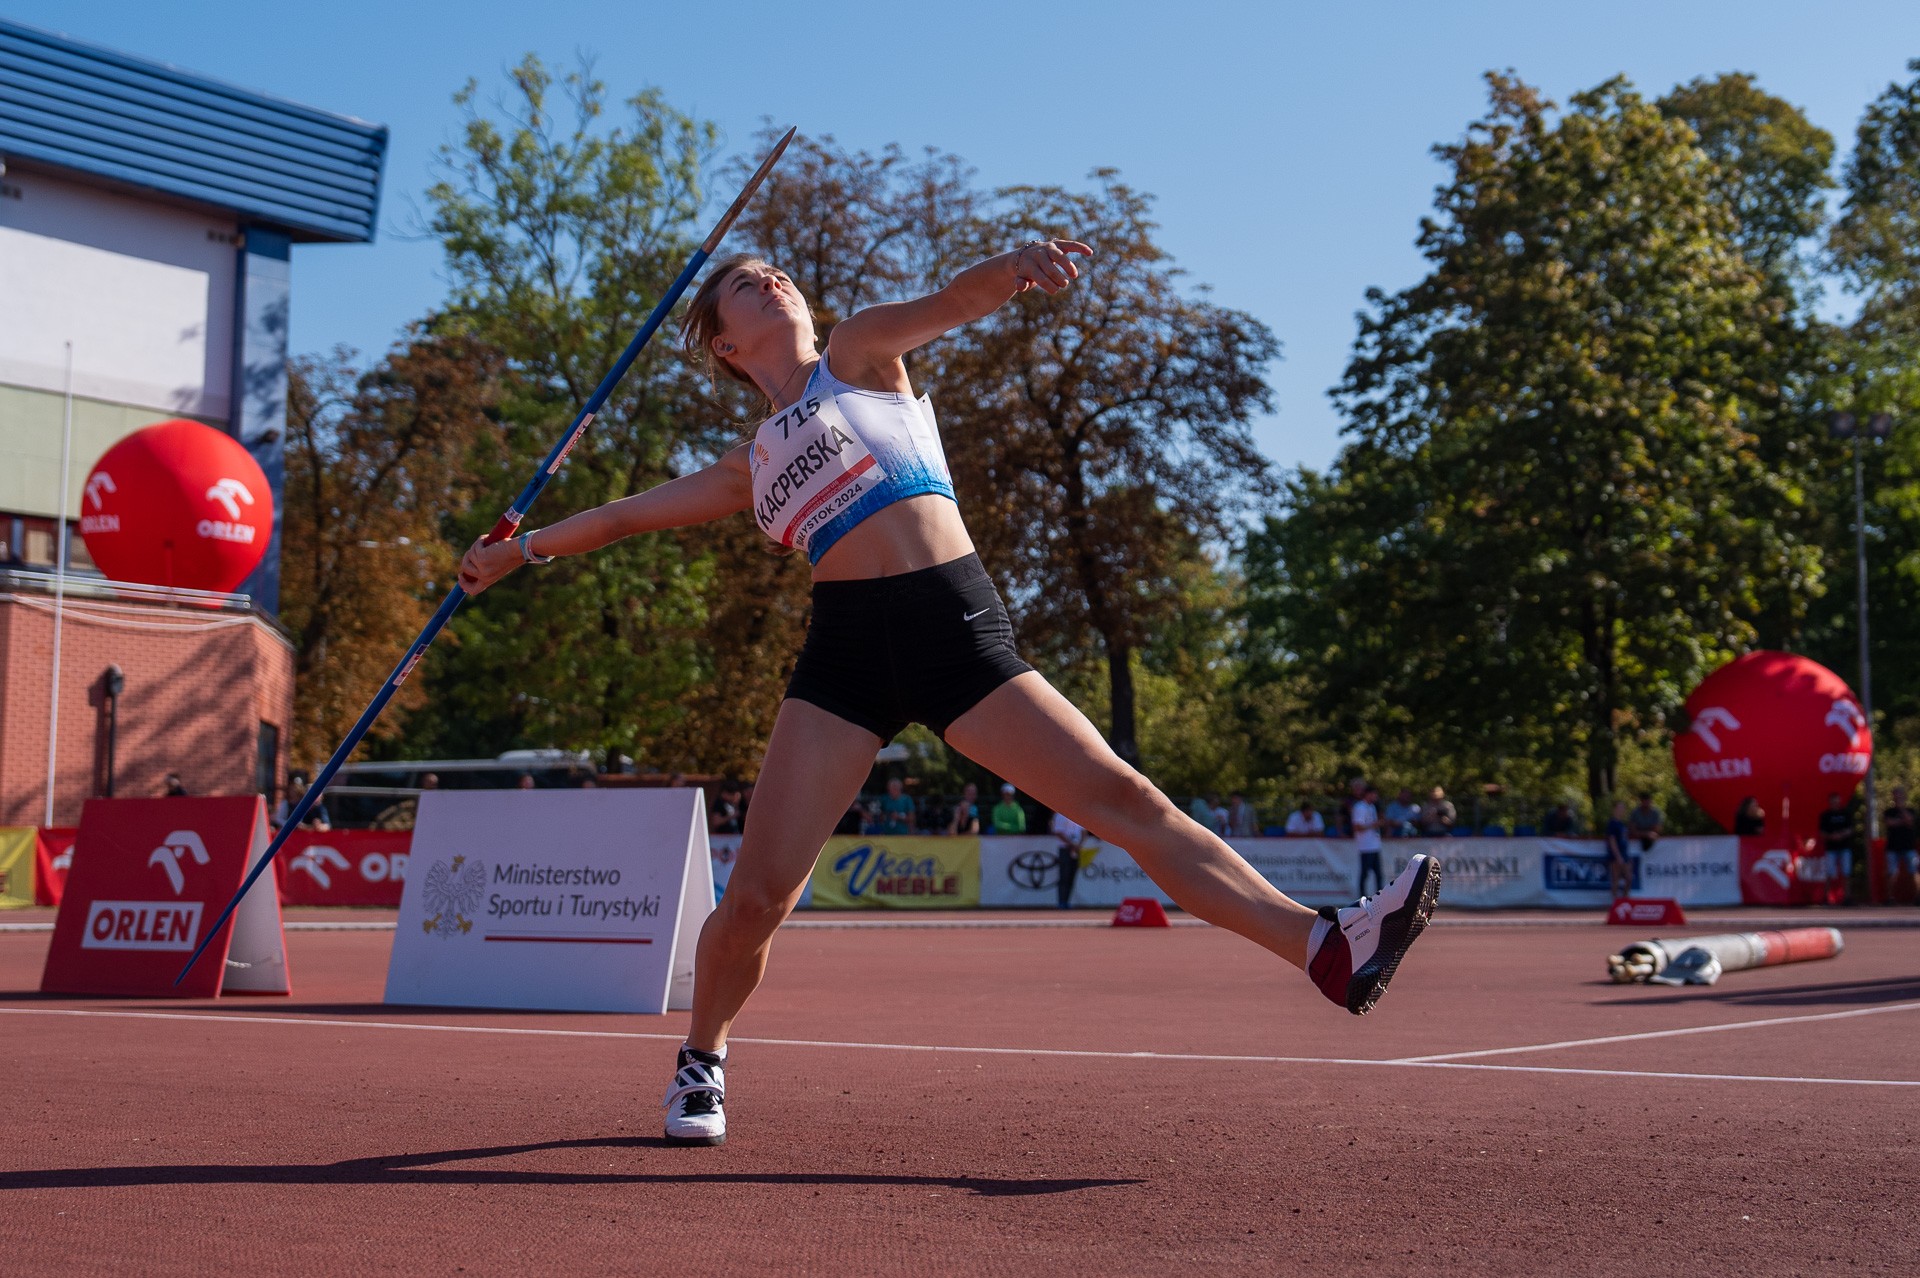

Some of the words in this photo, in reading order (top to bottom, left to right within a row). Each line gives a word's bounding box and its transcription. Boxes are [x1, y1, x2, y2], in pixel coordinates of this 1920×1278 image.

[774, 396, 821, 440] 715
[756, 425, 854, 531] KACPERSKA
[834, 483, 863, 508] 2024
[197, 520, 255, 544] ORLEN
[1687, 757, 1752, 781] ORLEN
[493, 862, 621, 886] Ministerstwo
[876, 876, 960, 896] MEBLE
[487, 893, 551, 919] Sportu
[557, 894, 564, 915] i
[570, 895, 661, 921] Turystyki
[92, 908, 194, 942] ORLEN
